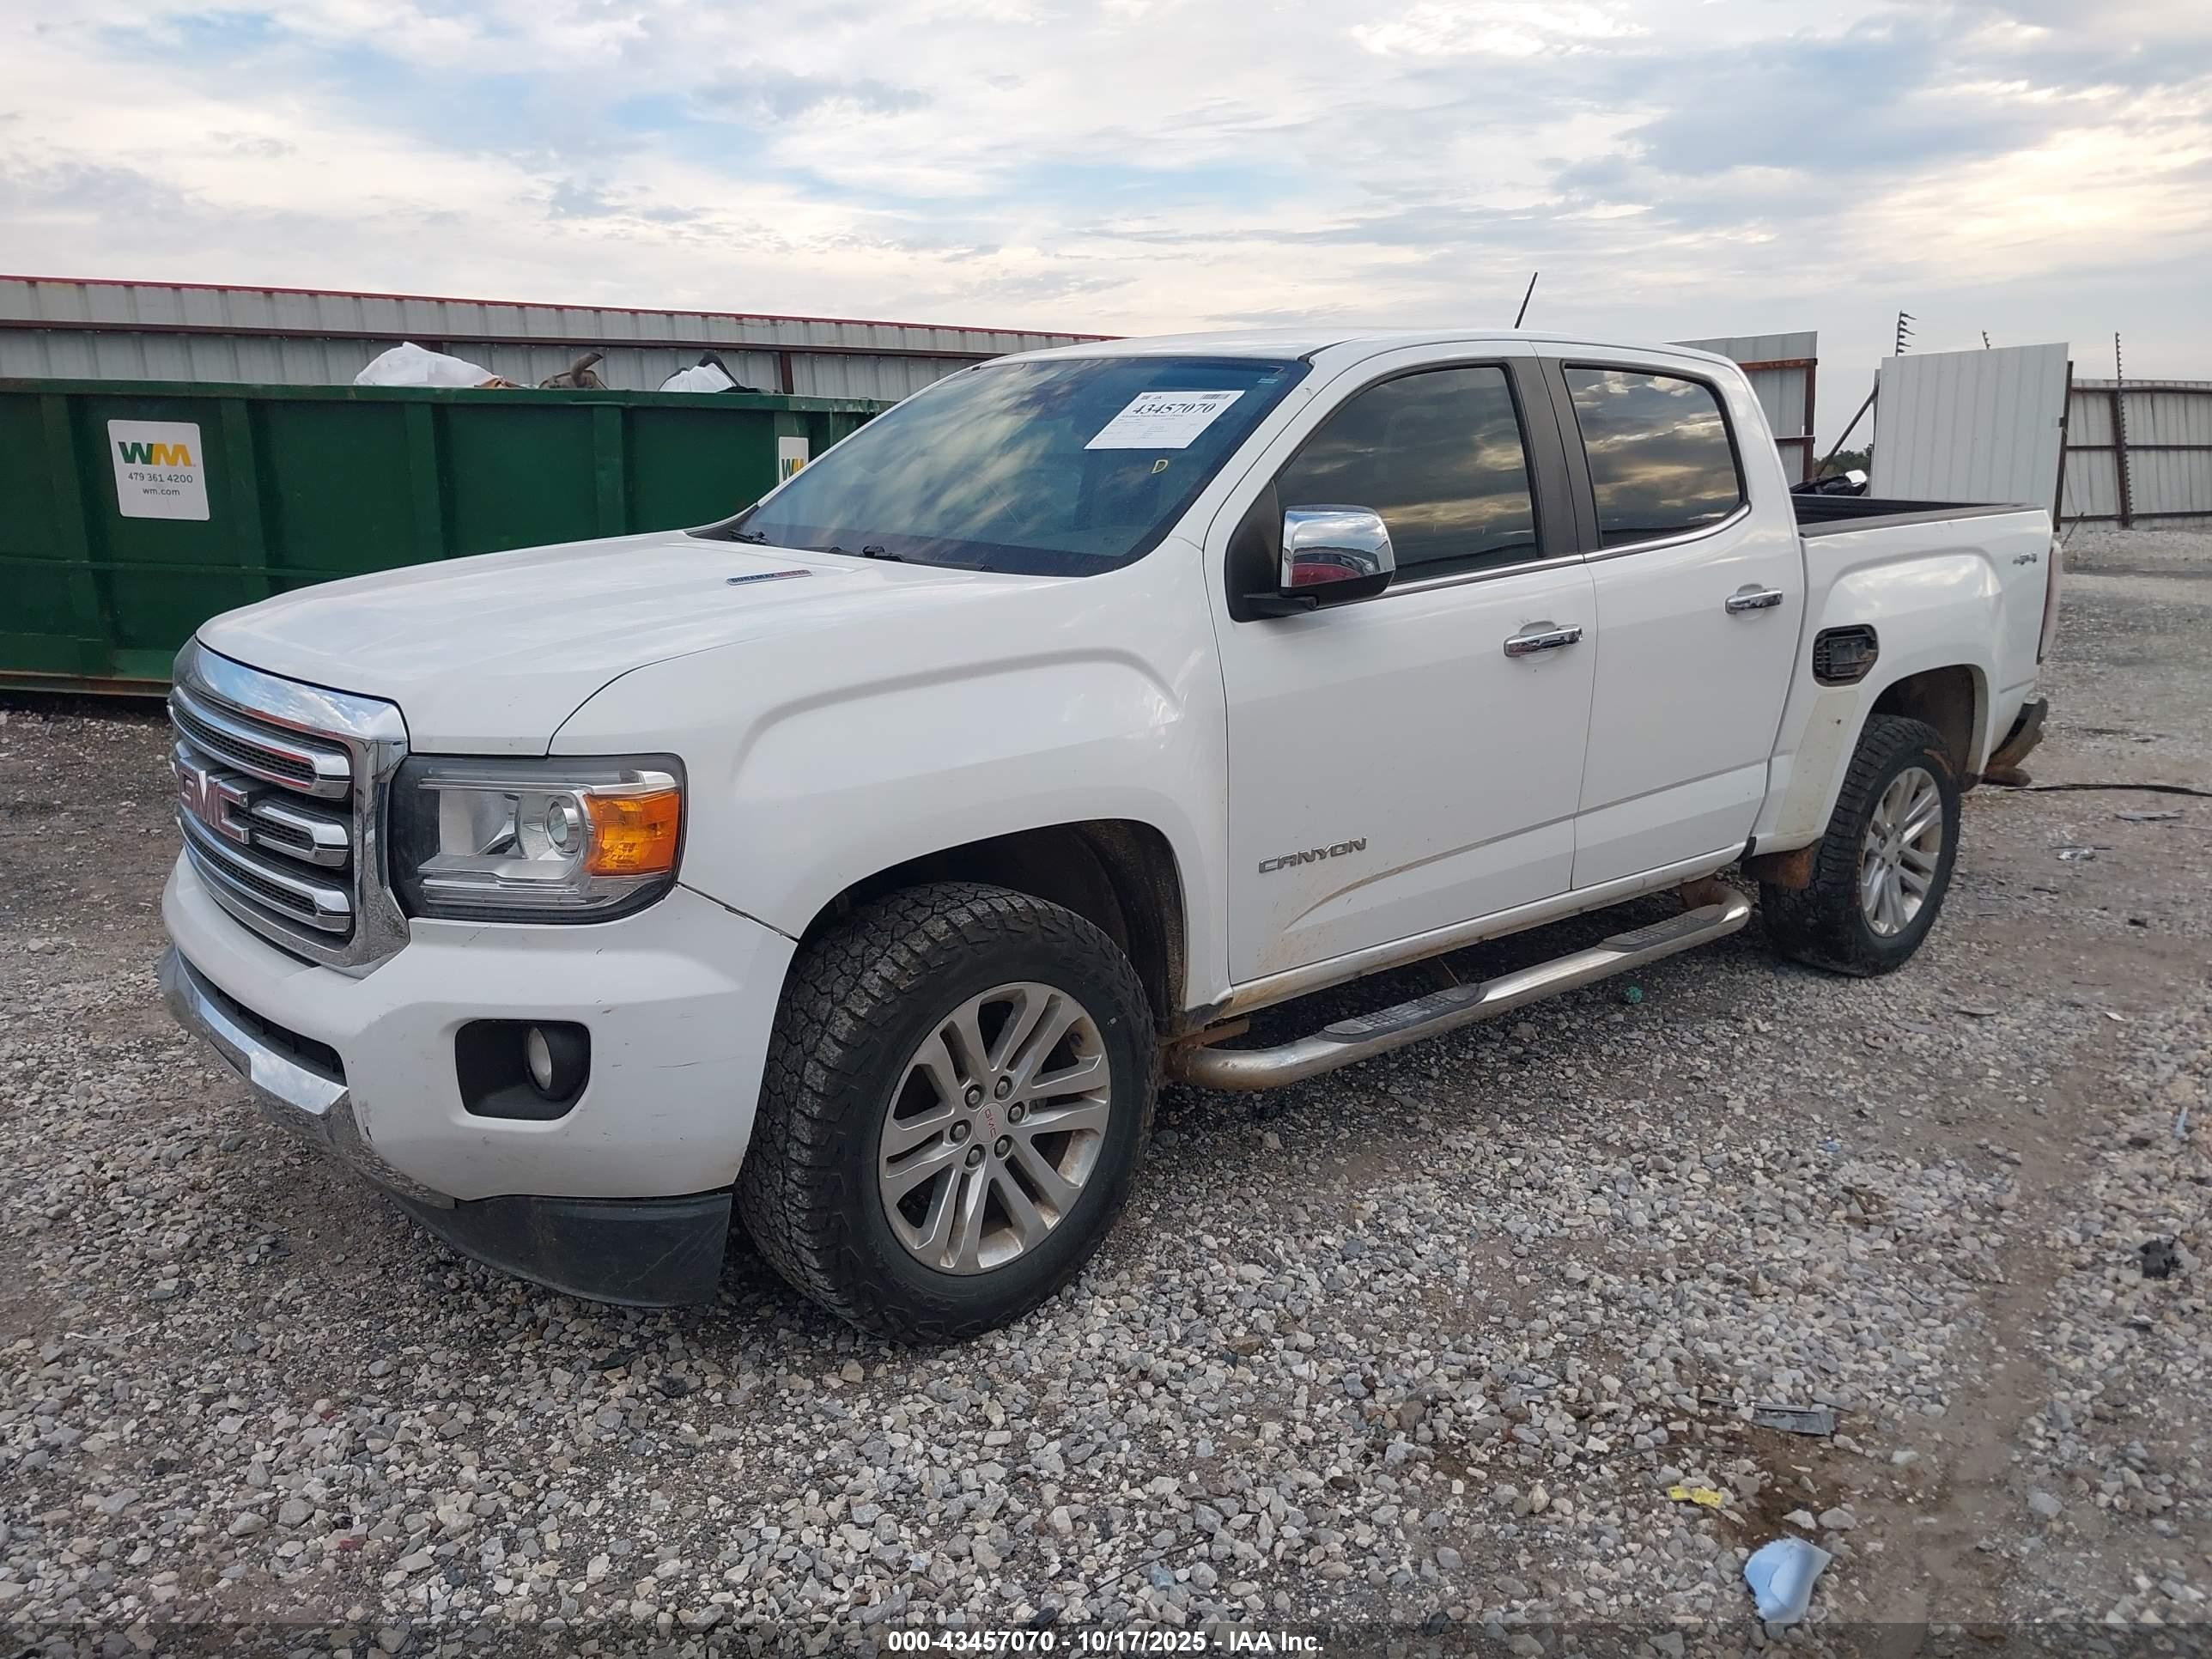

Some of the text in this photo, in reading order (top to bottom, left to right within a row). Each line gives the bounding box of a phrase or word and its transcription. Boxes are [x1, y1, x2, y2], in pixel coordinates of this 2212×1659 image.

[1133, 403, 1216, 414] 43457070
[118, 441, 193, 467] WM
[128, 472, 193, 483] 479 361 4200
[178, 758, 249, 844] GMC
[1258, 837, 1367, 873] CANYON
[985, 1109, 996, 1138] GMC
